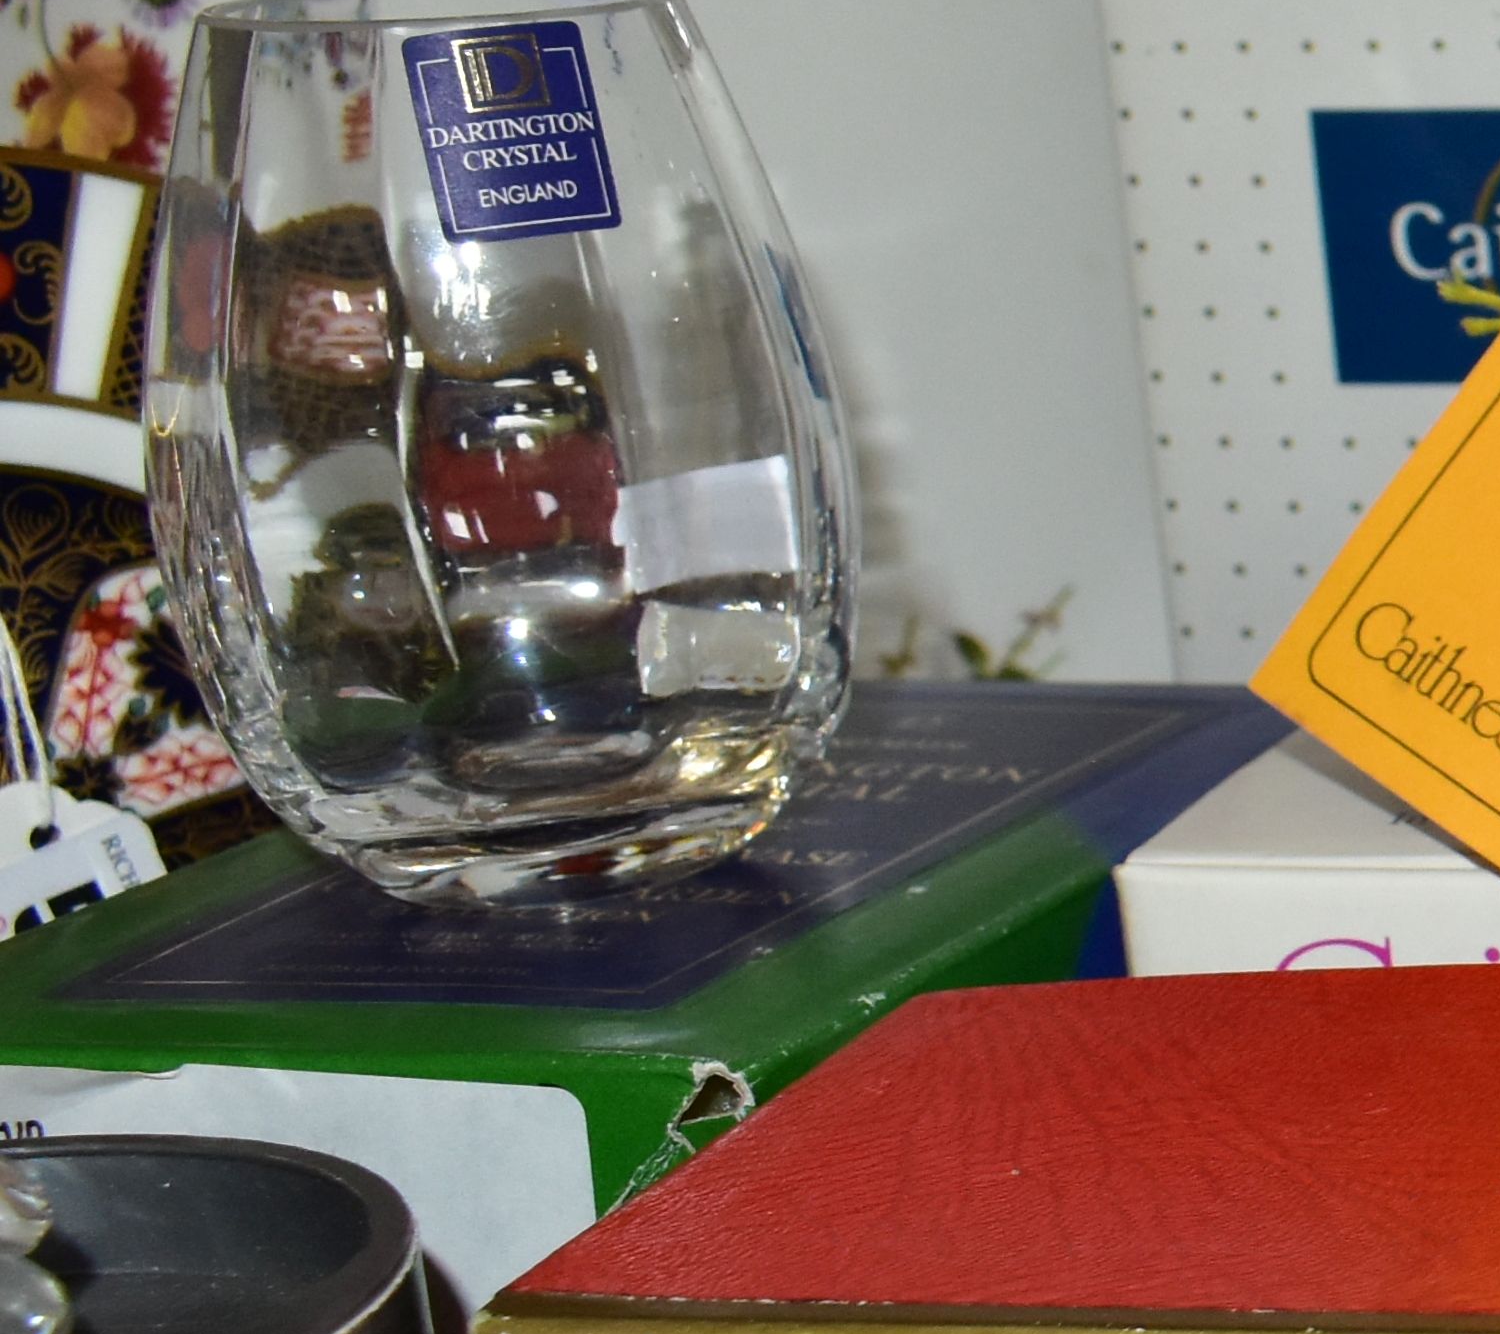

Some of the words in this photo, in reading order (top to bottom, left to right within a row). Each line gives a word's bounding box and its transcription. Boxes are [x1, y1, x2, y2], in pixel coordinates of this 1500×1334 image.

[427, 112, 595, 148] DARTINGTON
[463, 141, 577, 172] CRYSTAL
[478, 179, 578, 207] ENGLAND
